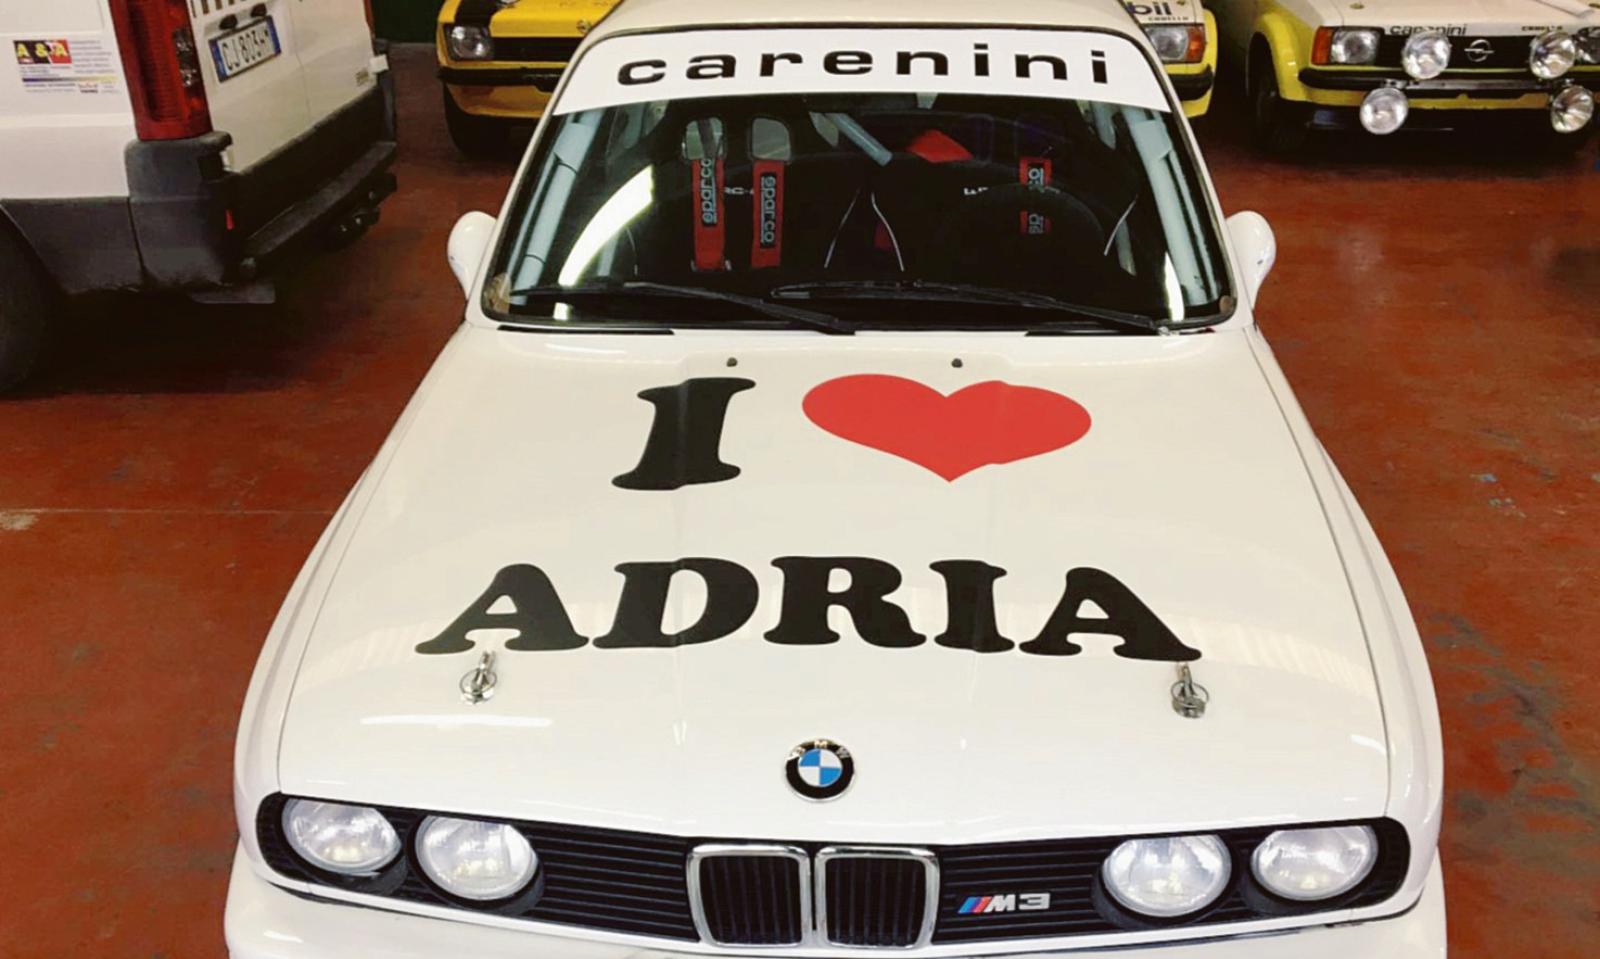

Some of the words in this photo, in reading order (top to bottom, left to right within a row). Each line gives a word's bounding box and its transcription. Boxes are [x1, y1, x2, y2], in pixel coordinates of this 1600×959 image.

[618, 46, 1109, 85] carenini
[760, 175, 776, 244] sparco
[612, 376, 756, 491] I
[416, 555, 1202, 661] ADRIA
[980, 892, 1051, 915] M3
